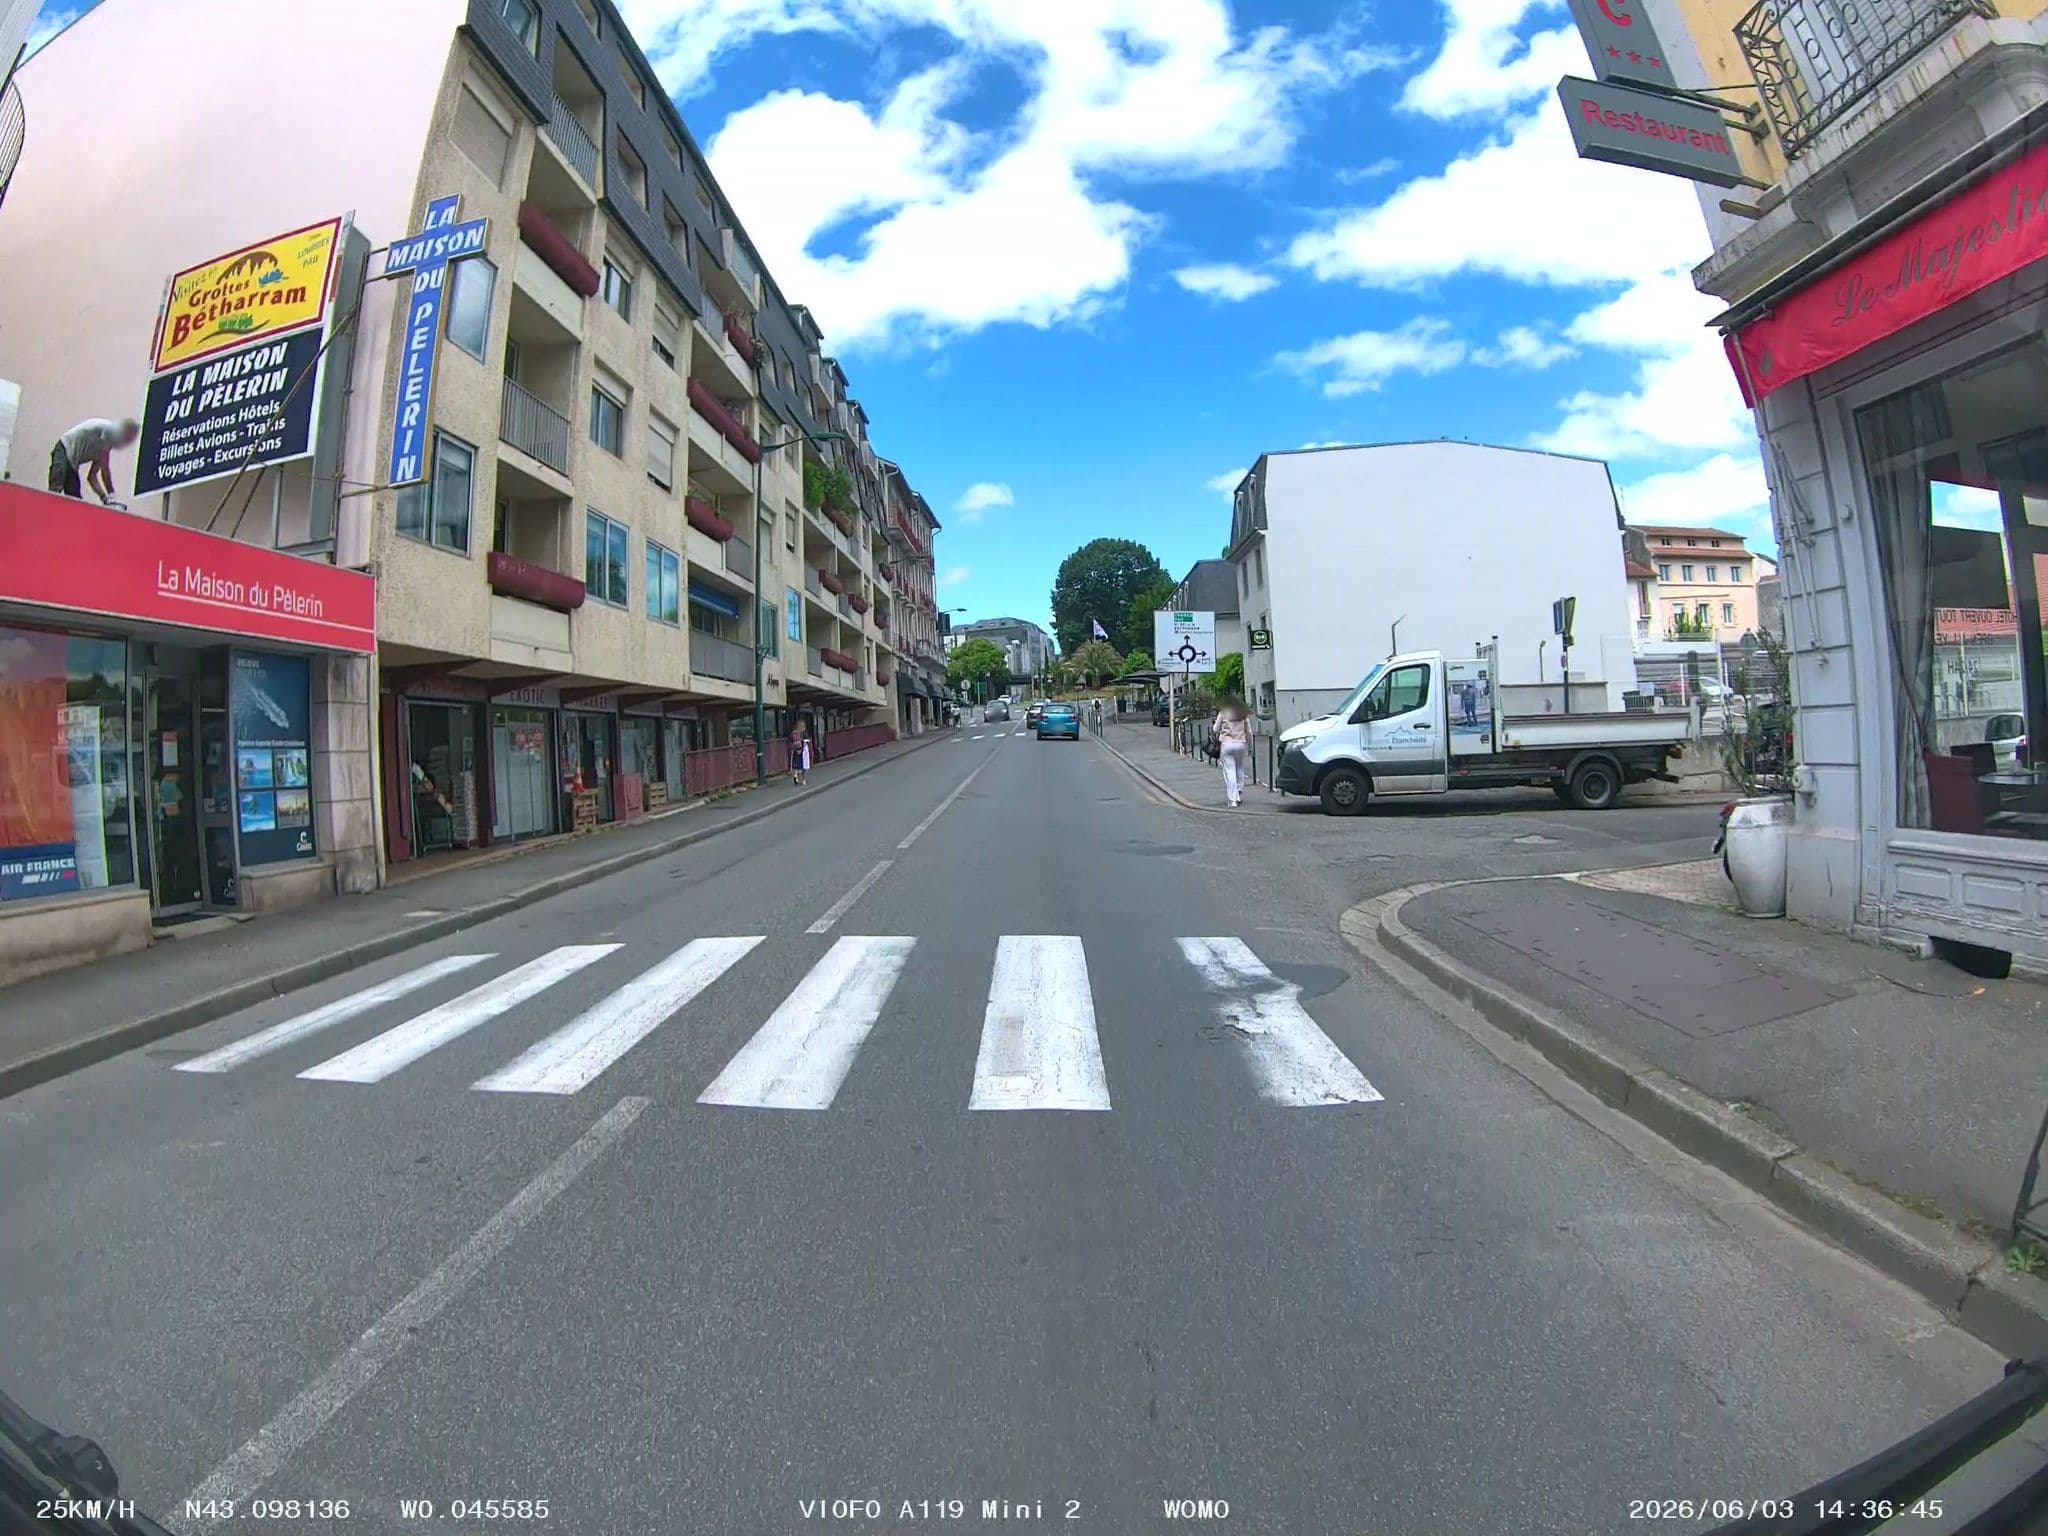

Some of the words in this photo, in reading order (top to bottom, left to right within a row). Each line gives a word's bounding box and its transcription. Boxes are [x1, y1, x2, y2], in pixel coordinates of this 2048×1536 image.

[1579, 98, 1730, 156] Restaurant
[425, 205, 456, 231] LA
[388, 225, 485, 269] MAISON
[188, 279, 250, 308] Grottes
[414, 266, 445, 293] DU
[1831, 272, 1879, 327] Le
[171, 286, 307, 348] Bétharram
[172, 369, 198, 397] LA
[201, 342, 289, 387] MAISON
[396, 302, 433, 482] PELERIN
[164, 395, 195, 424] DU
[198, 368, 289, 413] PÈLERIN
[161, 413, 236, 445] Réservations
[238, 400, 281, 423] Hôtels
[158, 457, 206, 480] Voyages
[159, 441, 194, 463] Billets
[196, 431, 237, 452] Avions
[157, 560, 179, 591] La
[185, 566, 244, 604] Maison
[249, 581, 269, 608] du
[1, 863, 24, 876] AIR
[26, 857, 76, 873] FRANCE
